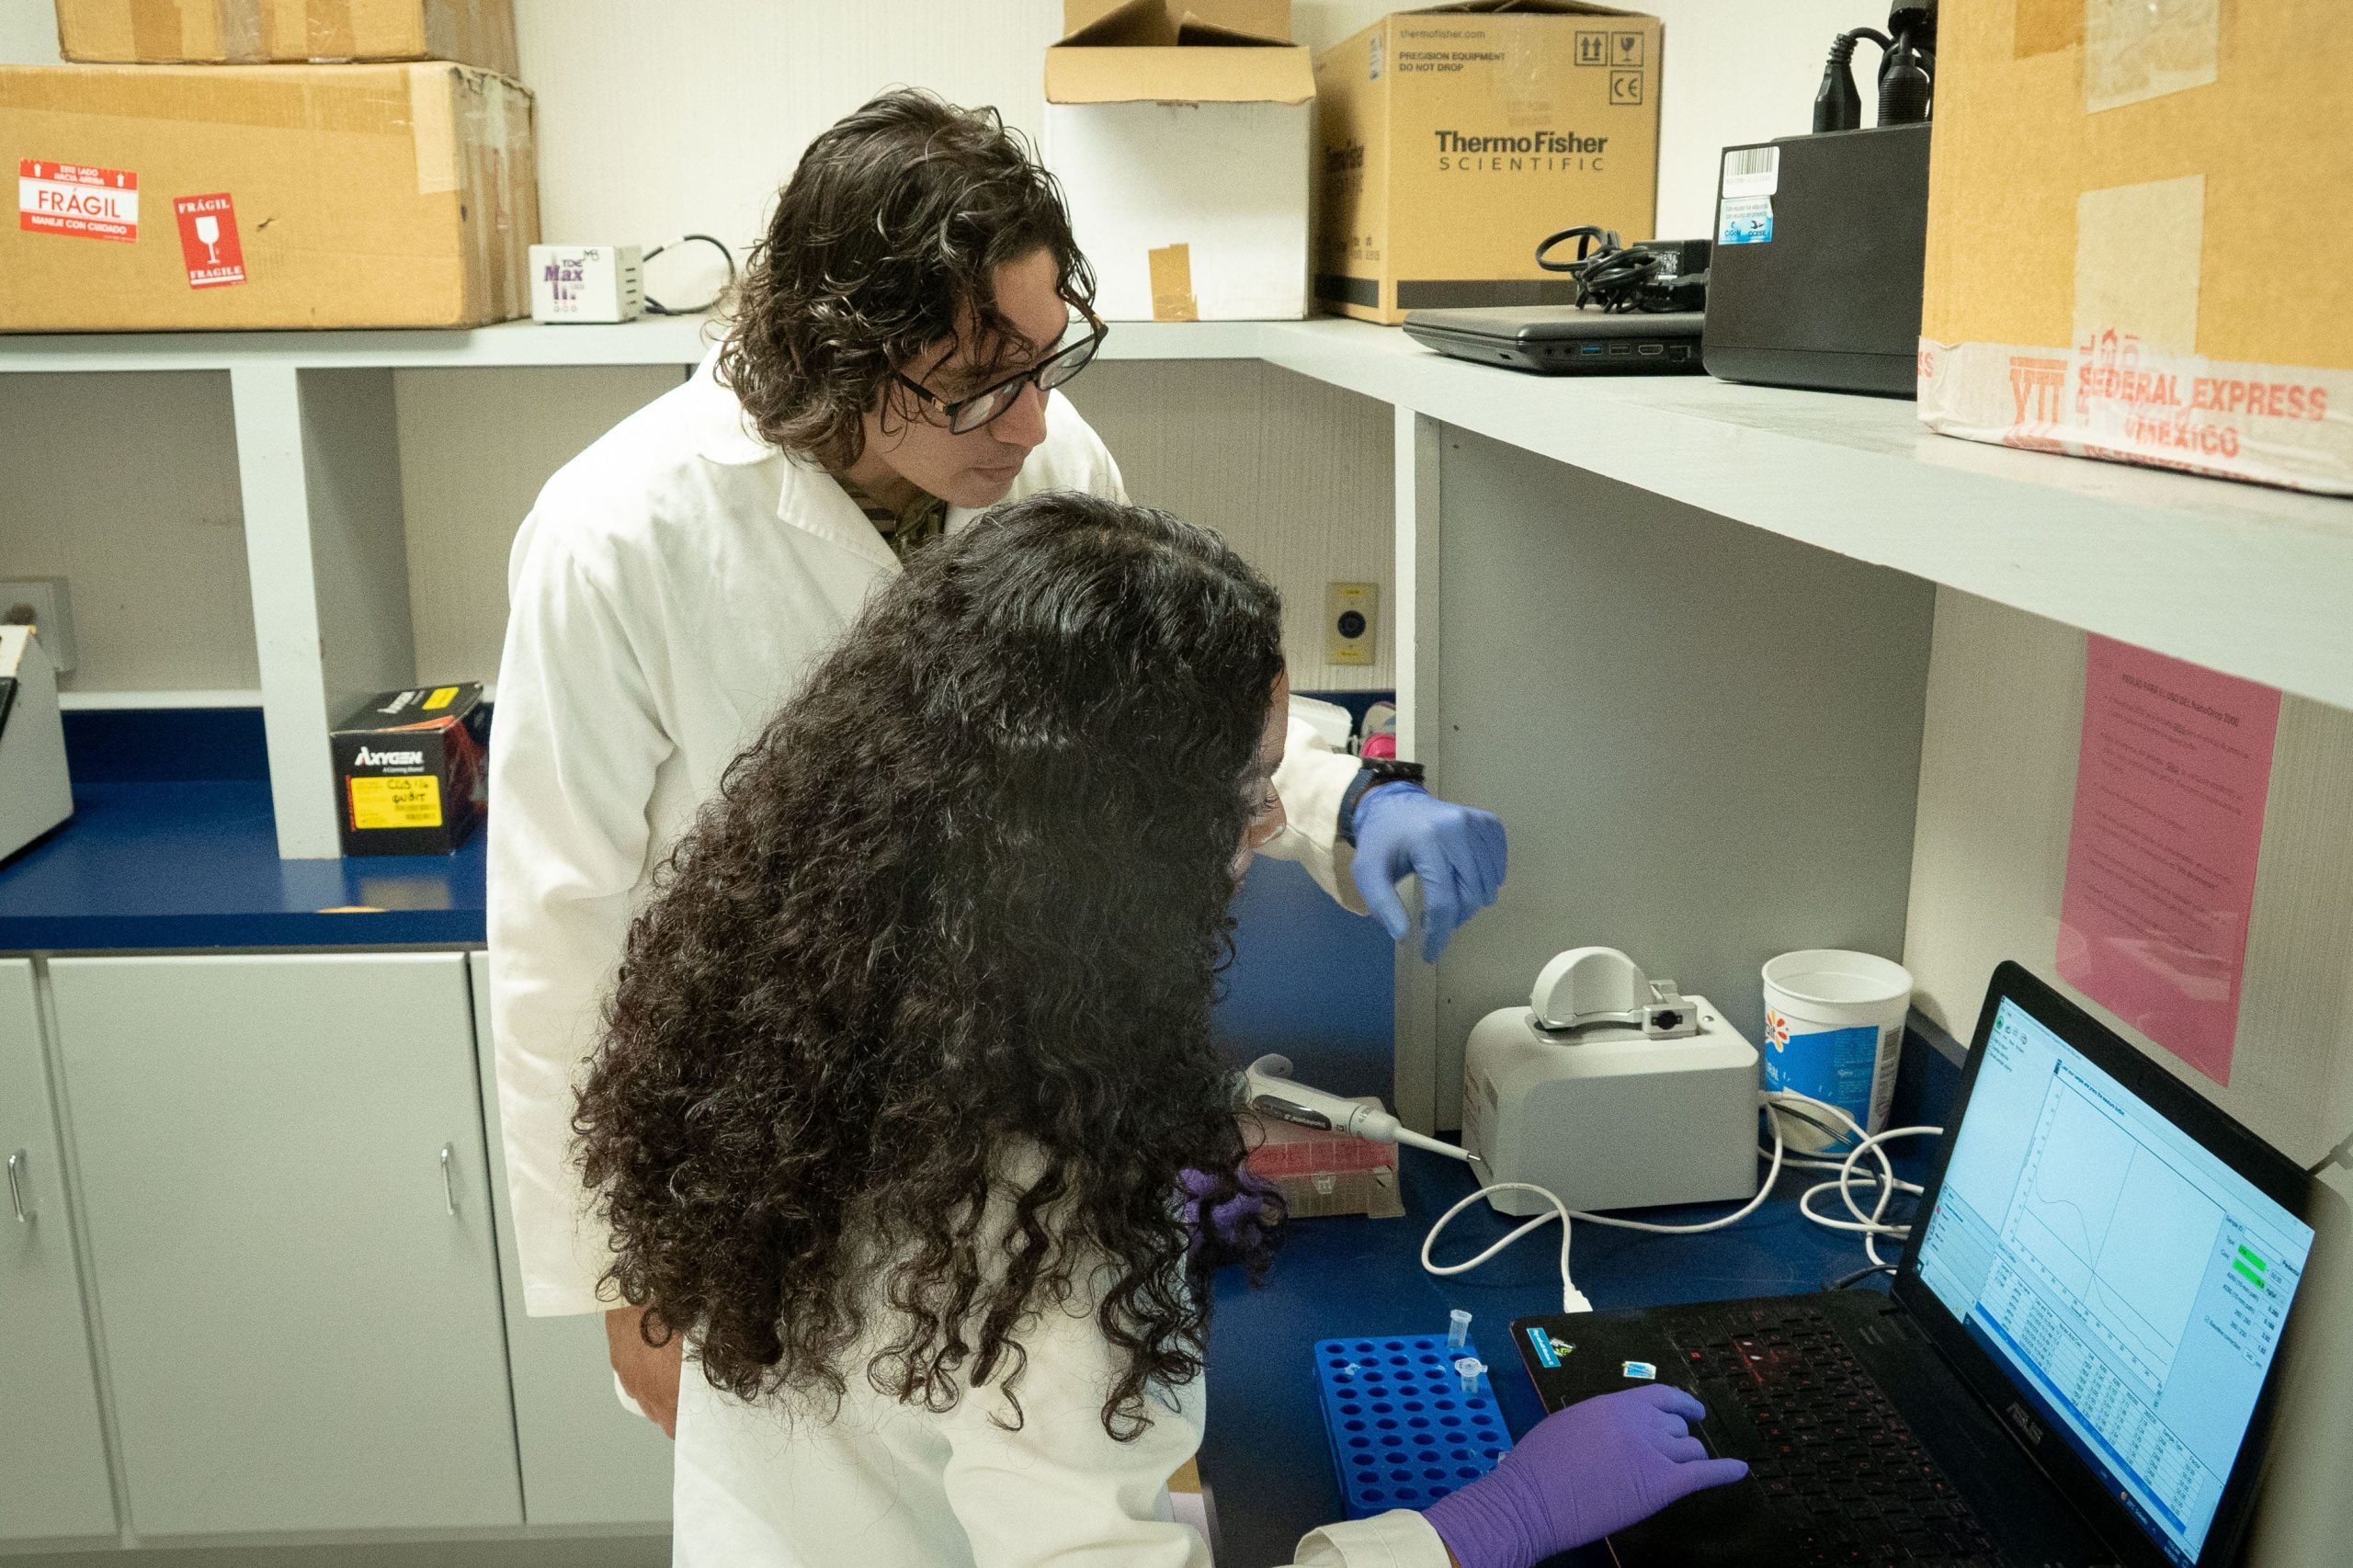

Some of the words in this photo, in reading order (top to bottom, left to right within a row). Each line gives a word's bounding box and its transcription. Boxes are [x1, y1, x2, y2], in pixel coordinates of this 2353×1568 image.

[1399, 29, 1486, 40] thermofisher.com
[1399, 51, 1450, 62] PRECISION
[1399, 63, 1414, 73] DO
[1415, 63, 1436, 73] NOT
[1438, 63, 1464, 73] DROP
[60, 165, 76, 175] ESTE
[77, 167, 99, 177] LADO
[1439, 157, 1605, 171] SCIENTIFIC
[53, 172, 78, 183] HACIA
[38, 187, 120, 218] FRÁGIL
[178, 199, 230, 214] FRÁGIL
[31, 215, 64, 227] MANEJE
[65, 220, 86, 230] CON
[87, 222, 127, 234] CUIDADO
[190, 265, 242, 279] FRAGILE
[543, 265, 584, 282] Max
[2190, 378, 2329, 422] EXPRESS
[354, 746, 424, 766] AXYGEN
